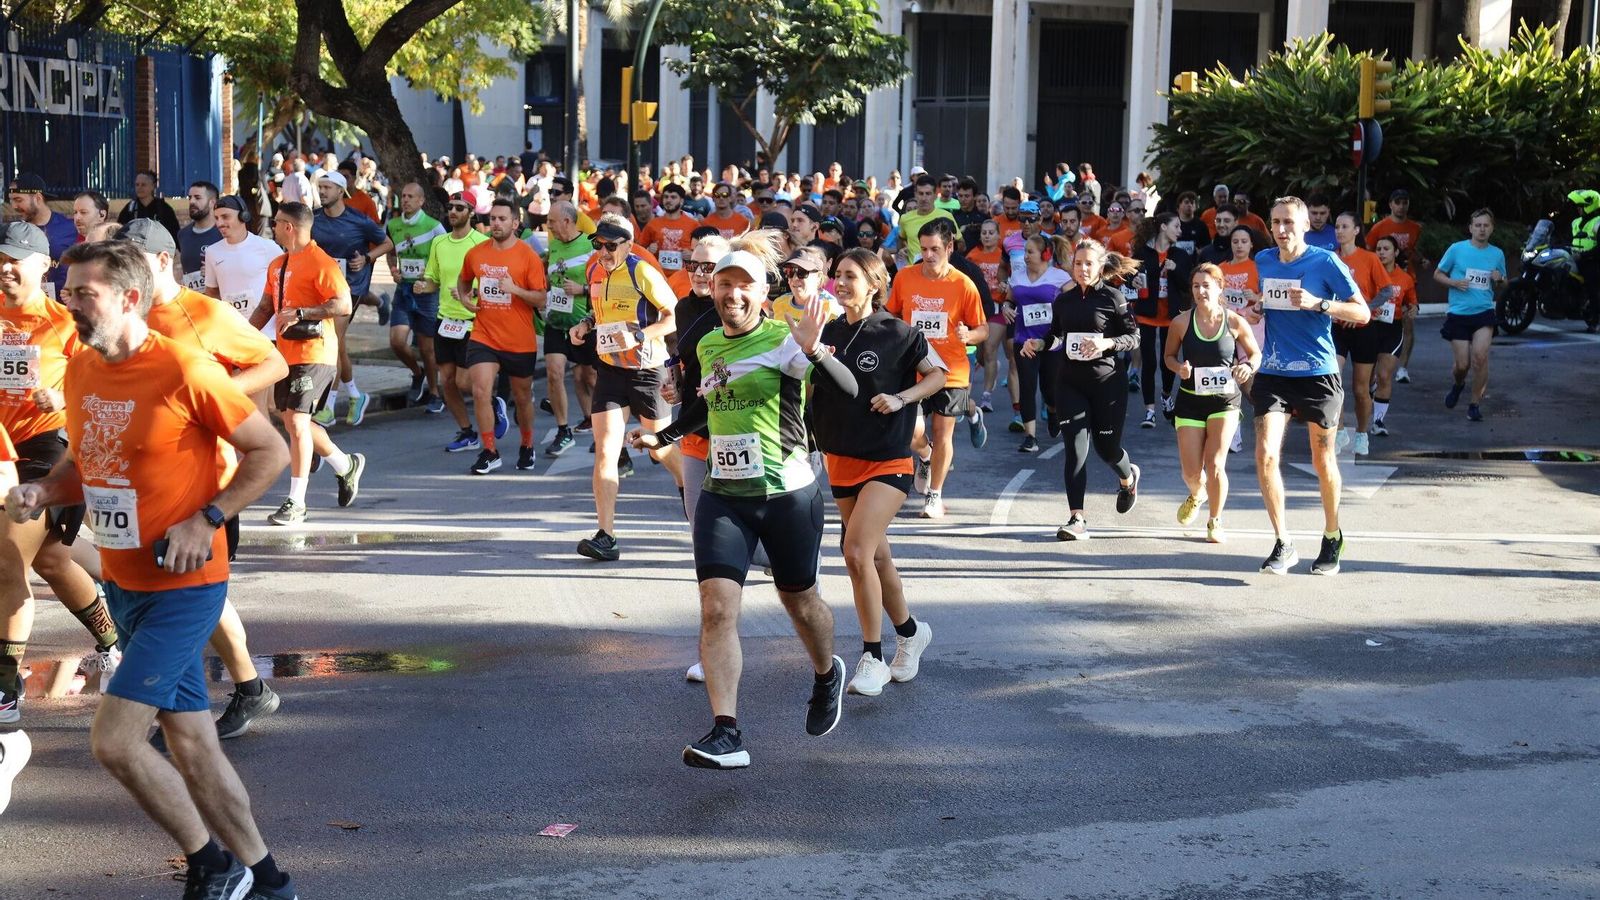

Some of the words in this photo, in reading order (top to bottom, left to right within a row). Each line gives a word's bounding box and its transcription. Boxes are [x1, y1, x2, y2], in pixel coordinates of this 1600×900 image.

[404, 265, 420, 273] 791
[1469, 275, 1487, 284] 798
[229, 300, 248, 310] 07
[1028, 310, 1047, 320] 191
[443, 323, 463, 333] 683
[916, 320, 941, 330] 684
[0, 360, 29, 376] 56
[1201, 376, 1228, 386] 619
[717, 450, 750, 466] 501
[92, 510, 129, 529] 770
[87, 600, 113, 634] VANS
